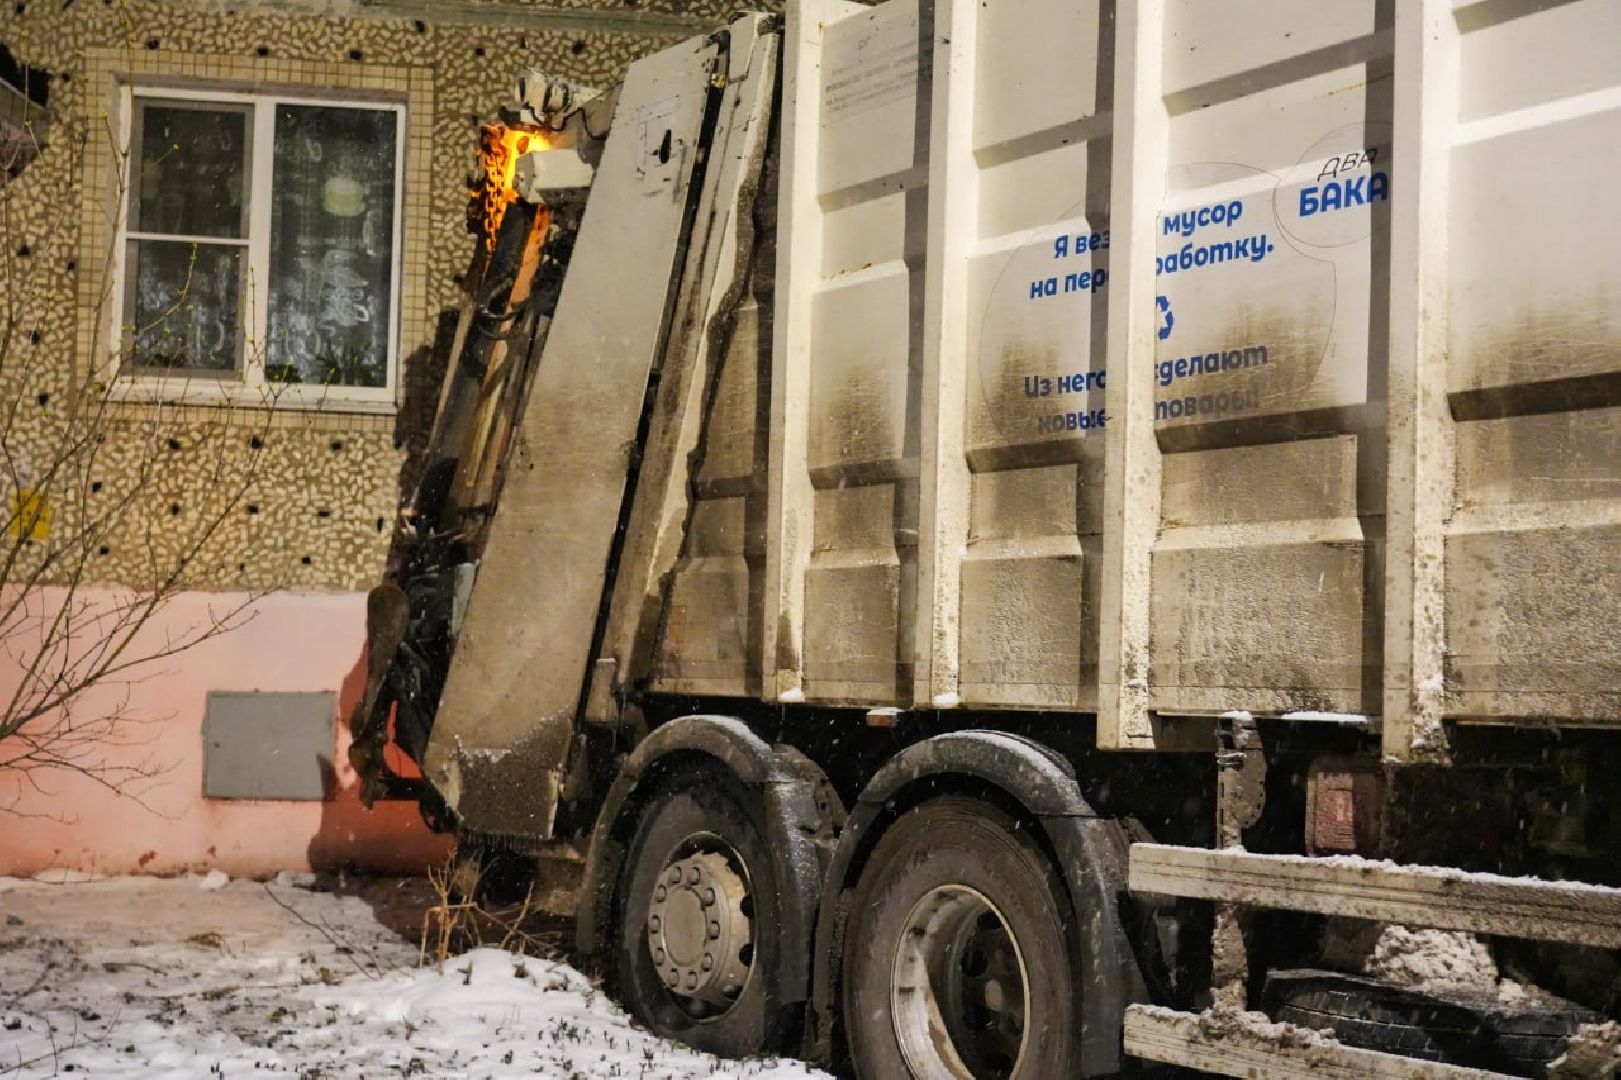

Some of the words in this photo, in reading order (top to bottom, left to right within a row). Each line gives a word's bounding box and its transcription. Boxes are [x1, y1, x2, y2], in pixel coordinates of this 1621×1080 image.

[1317, 148, 1378, 182] ДВА
[1299, 172, 1388, 217] БАКА
[1054, 234, 1069, 260] Я
[1162, 200, 1243, 237] мусор
[1030, 277, 1058, 300] на
[1064, 268, 1110, 294] пер
[1155, 345, 1268, 387] делают
